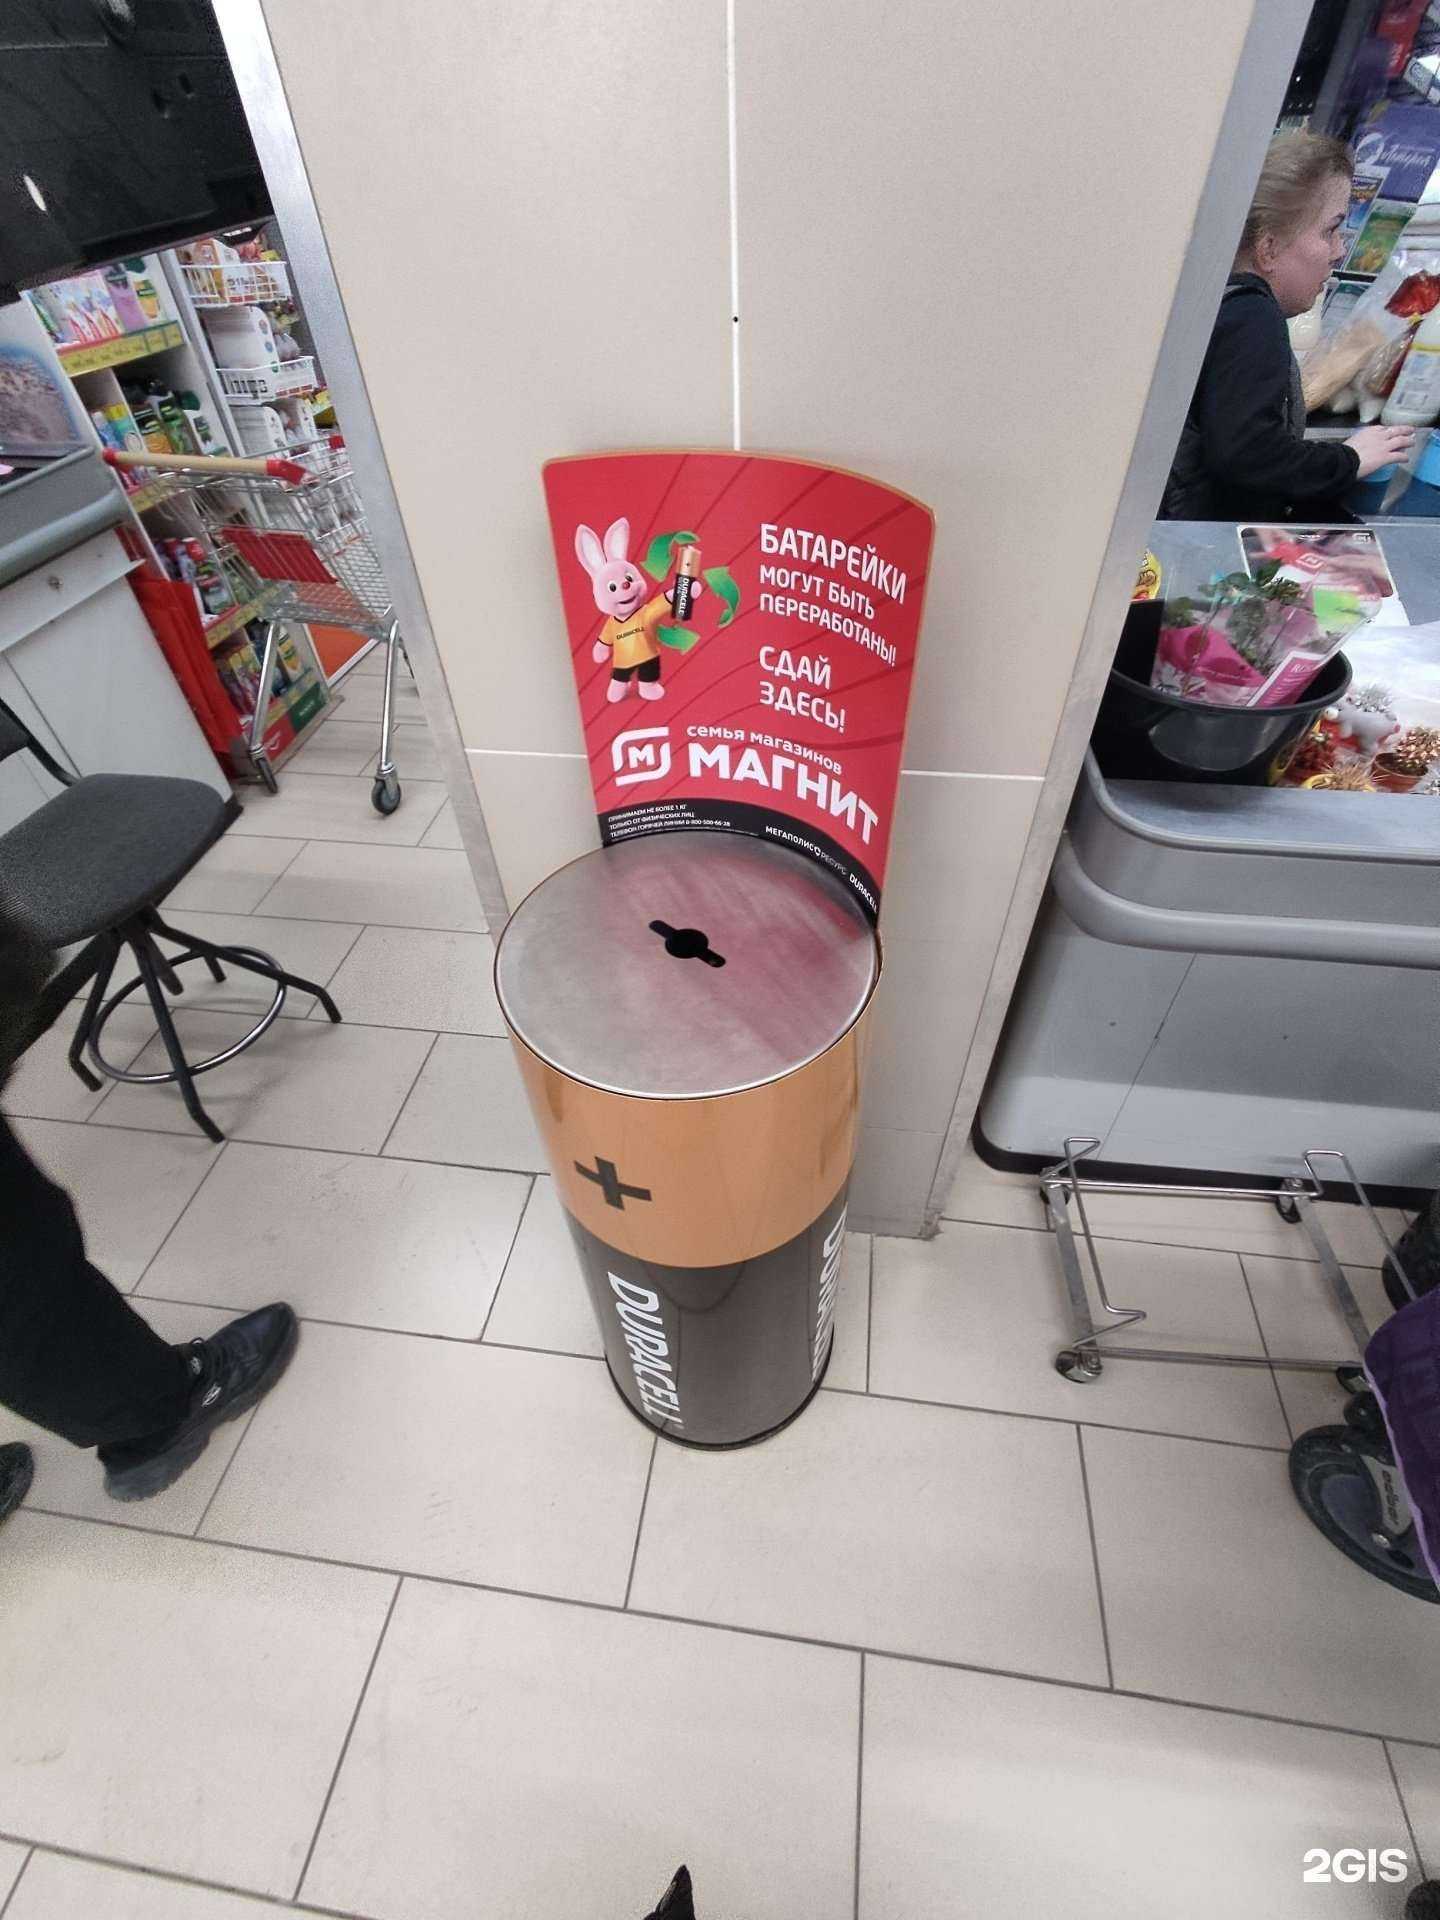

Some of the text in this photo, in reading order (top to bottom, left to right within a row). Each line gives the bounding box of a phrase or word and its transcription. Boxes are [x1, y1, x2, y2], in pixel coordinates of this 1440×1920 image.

[760, 564, 875, 620] МОГУТ БЫТЬ
[761, 523, 906, 605] БАТАРЕЙКИ
[760, 593, 896, 667] ПЕРЕРАБОТАНЫ!
[759, 645, 831, 690] СДАЙ
[759, 681, 846, 733] ЗДЕСЬ!
[687, 725, 842, 775] семья магазинов
[688, 742, 878, 845] МАГНИТ
[607, 1271, 681, 1424] DURACELL
